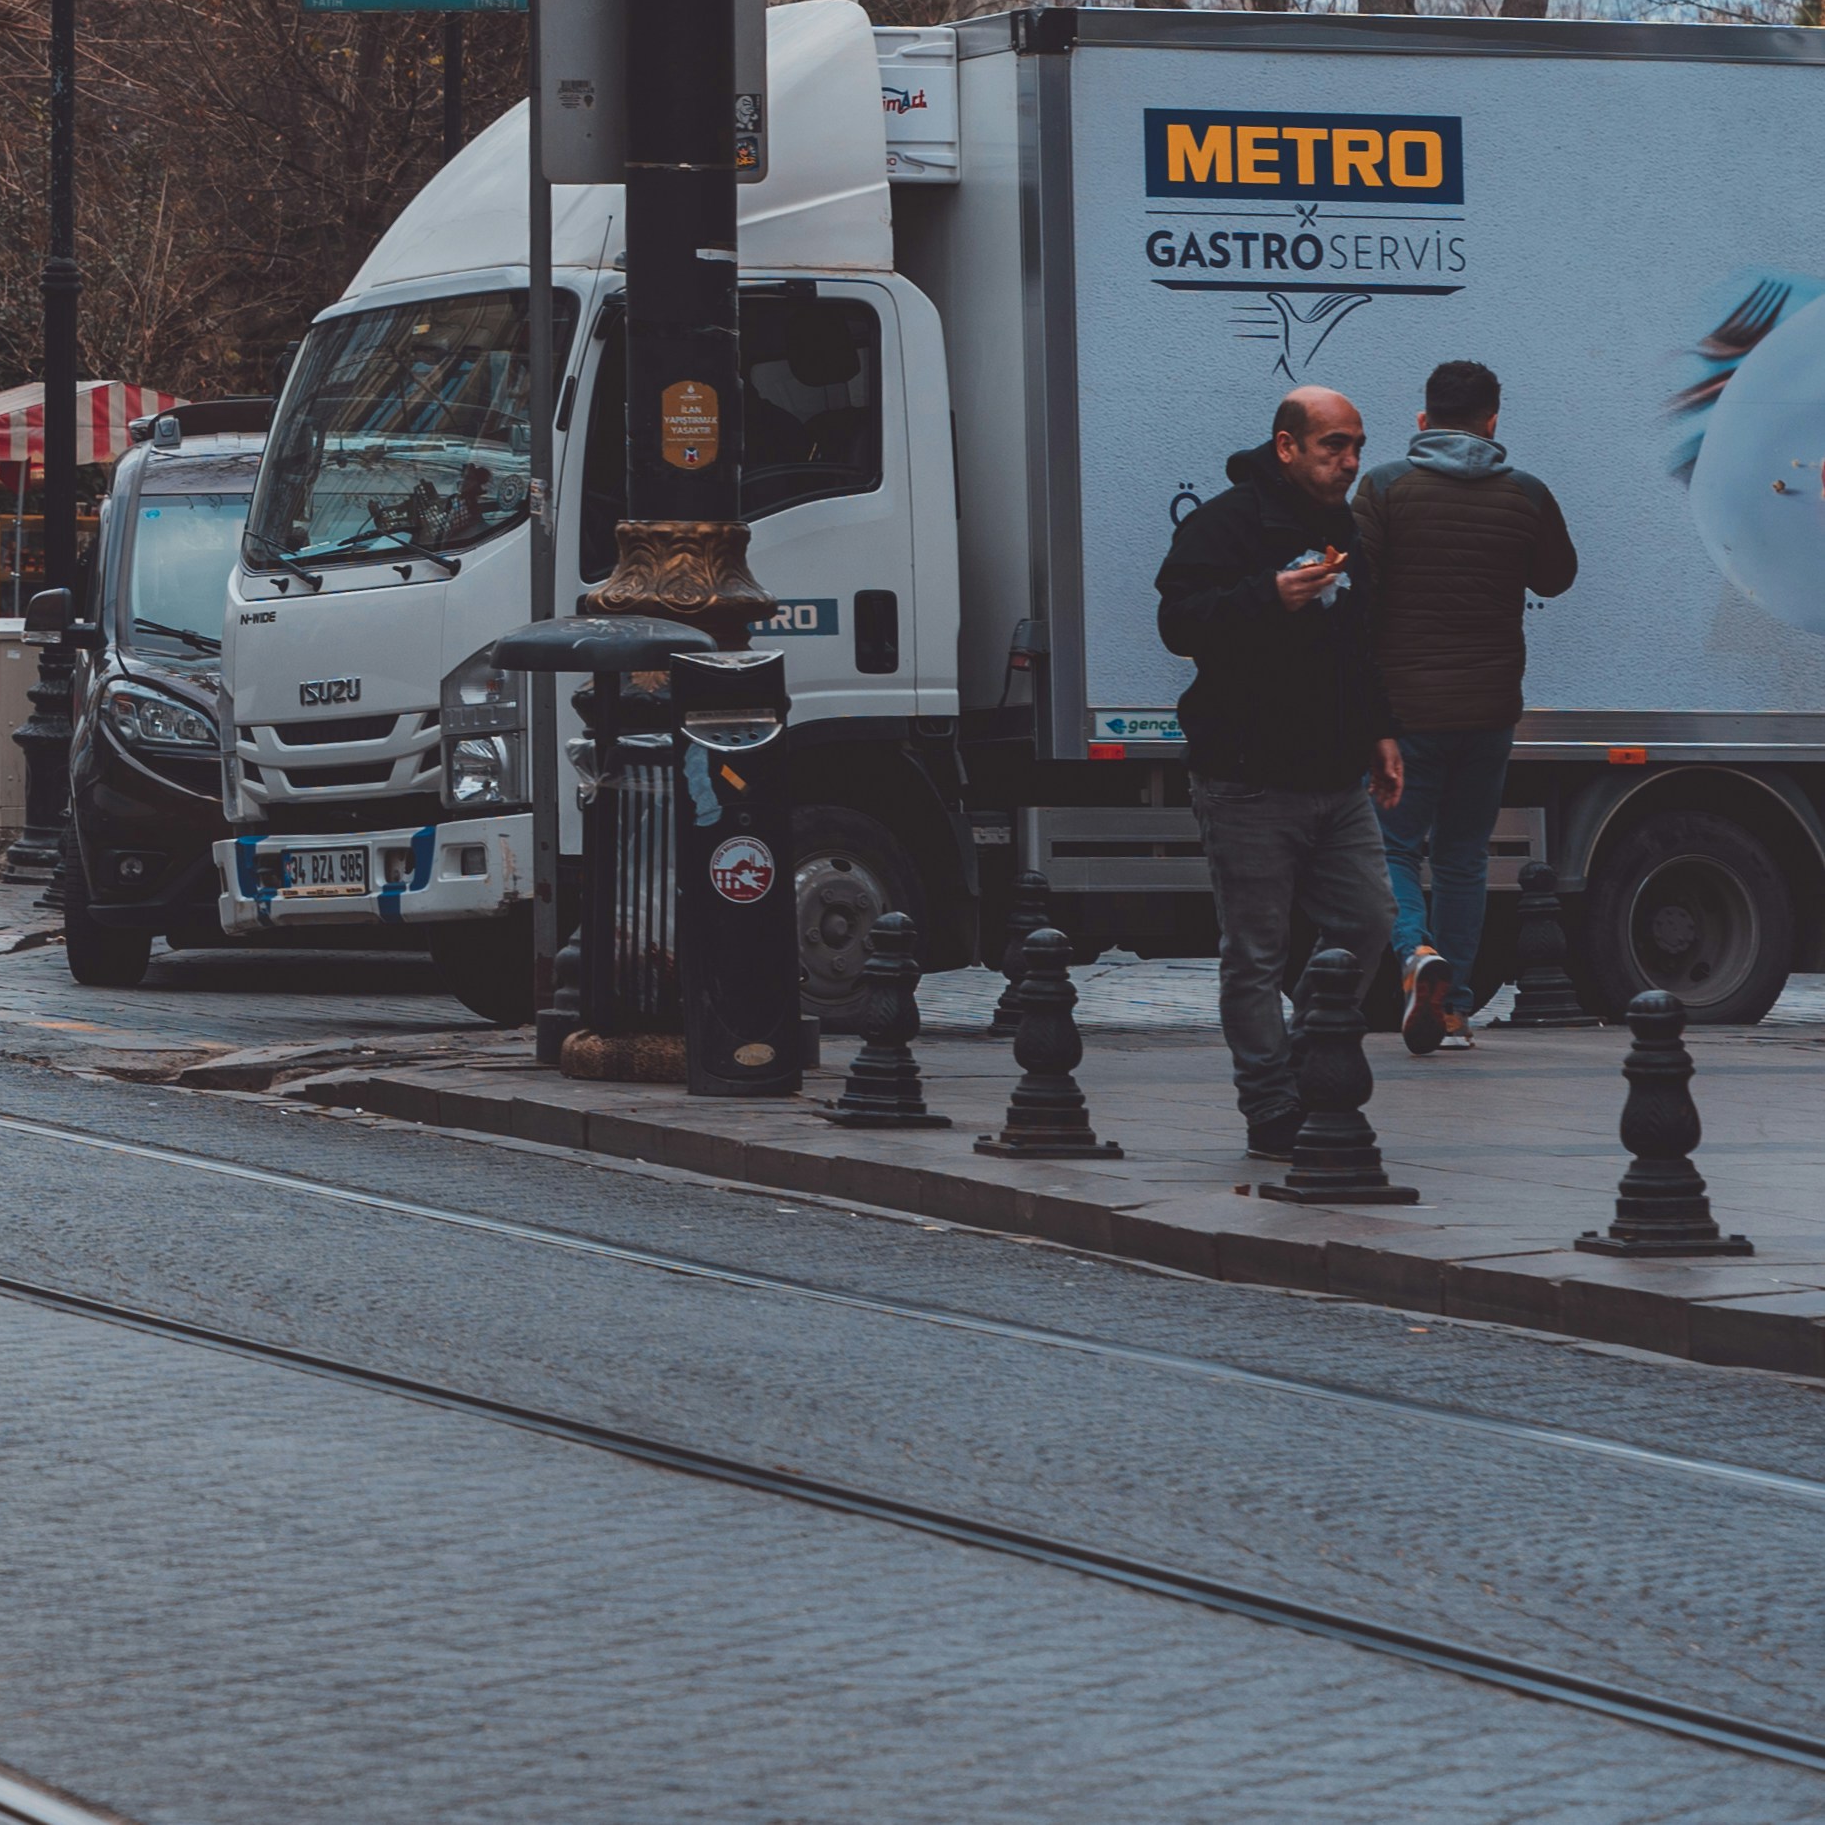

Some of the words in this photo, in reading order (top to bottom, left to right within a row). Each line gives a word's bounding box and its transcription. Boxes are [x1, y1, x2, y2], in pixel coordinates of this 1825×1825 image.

[1167, 124, 1443, 188] METRO
[240, 611, 276, 625] N-WIDE
[754, 604, 818, 630] RO
[300, 676, 362, 707] ISUZU
[290, 856, 305, 884] 34
[312, 855, 334, 883] BZA
